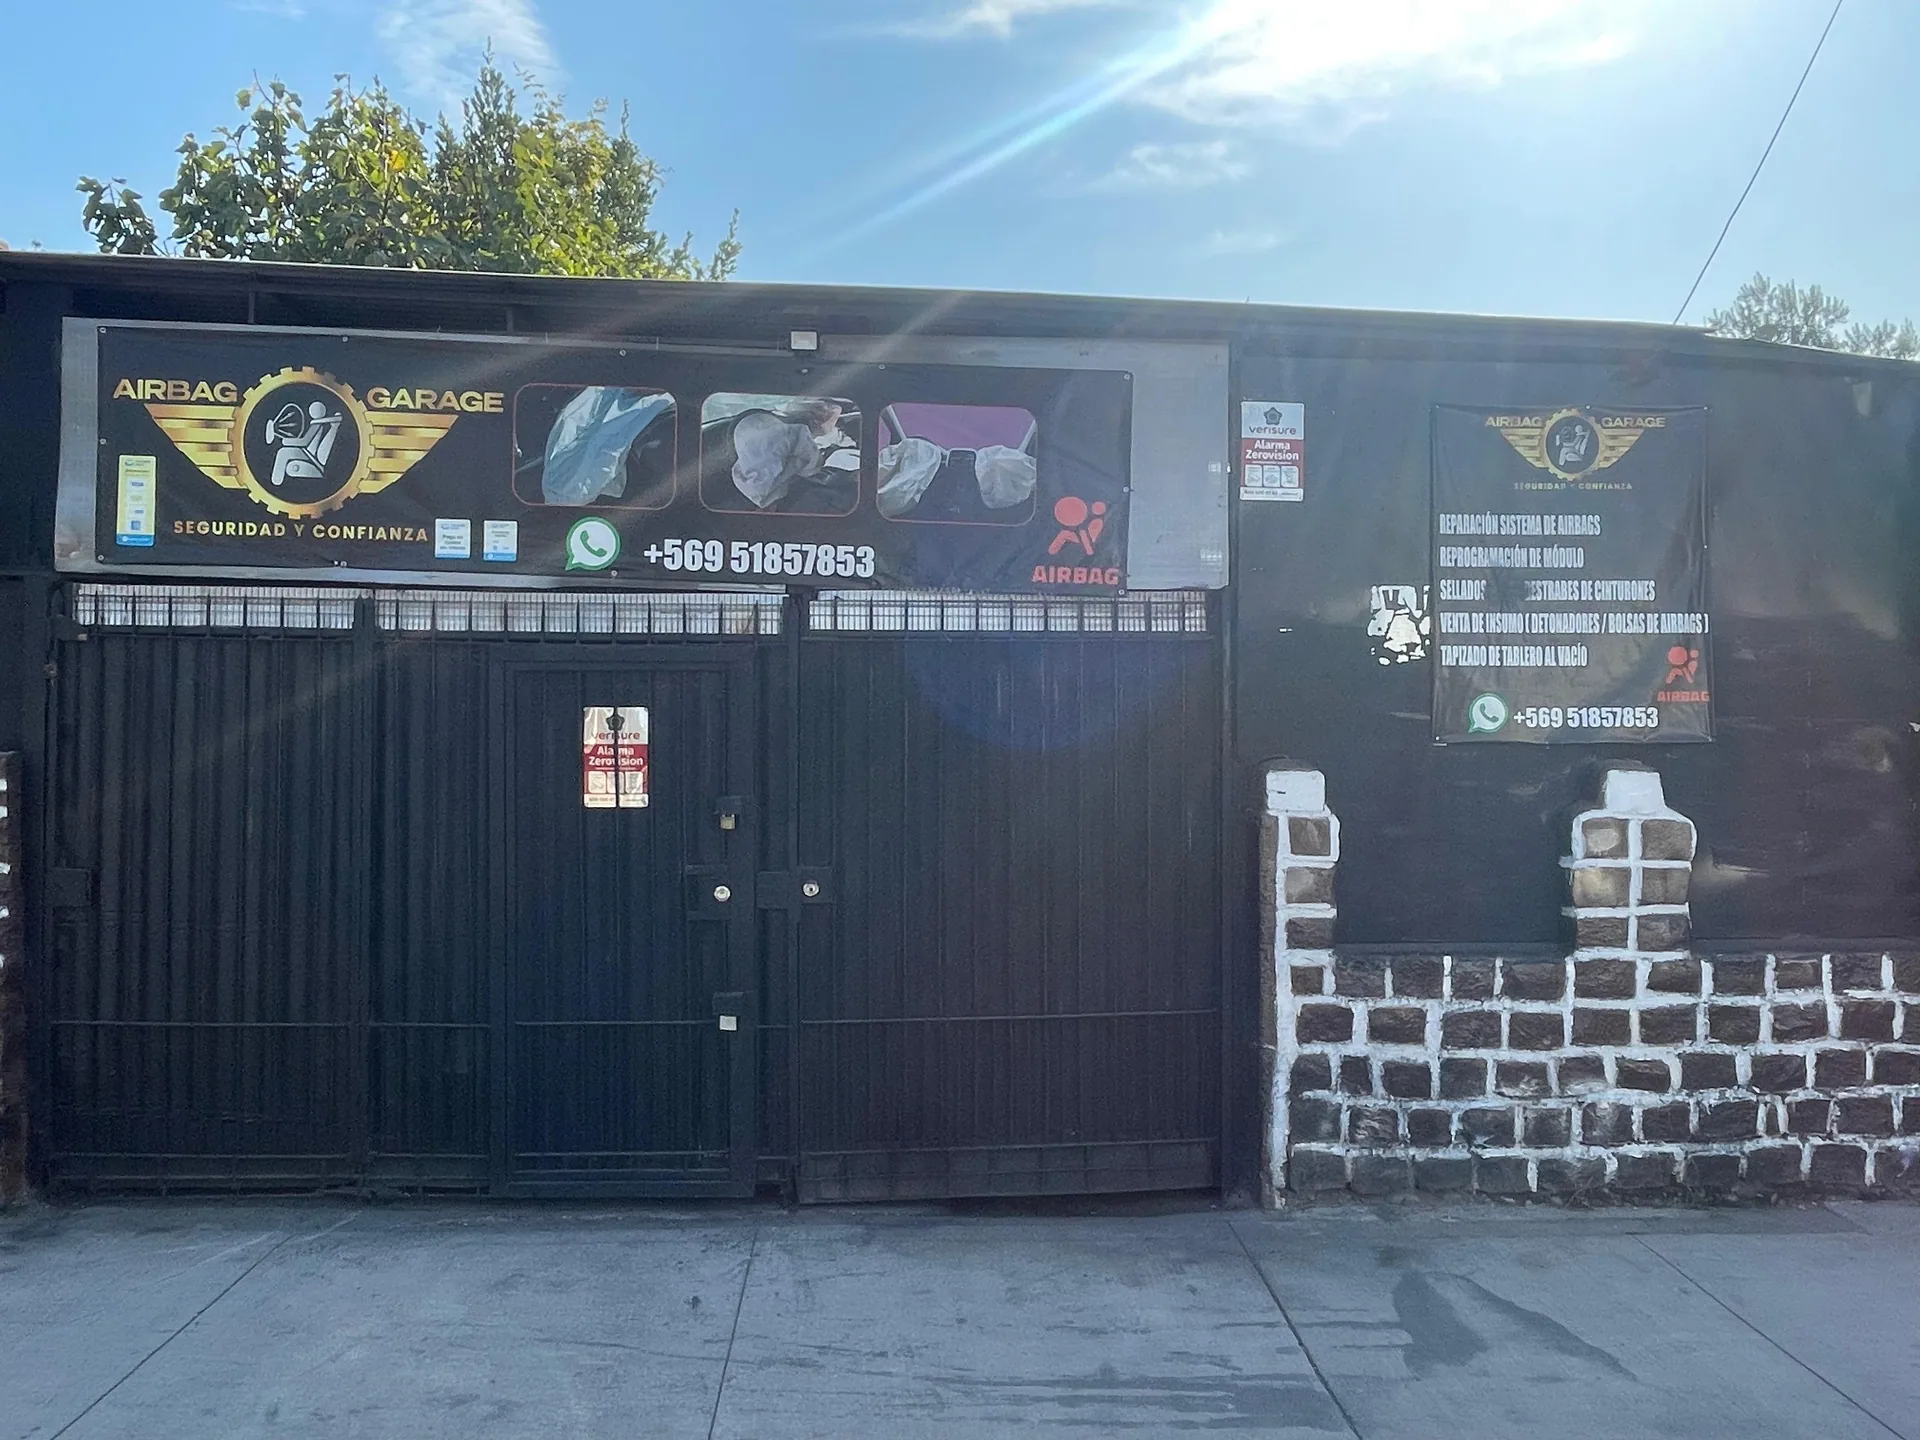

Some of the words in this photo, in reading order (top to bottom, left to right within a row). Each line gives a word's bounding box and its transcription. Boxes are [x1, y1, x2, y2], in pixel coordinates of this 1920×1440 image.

[113, 378, 238, 402] AIRBAG
[366, 386, 505, 413] GARAGE
[1248, 426, 1297, 435] verisure
[1485, 416, 1543, 427] AIRBAG
[1601, 417, 1666, 428] GARAGE
[1245, 449, 1299, 460] Zerovision
[1254, 440, 1290, 450] Alarma
[173, 520, 286, 538] SEGURIDAD
[294, 524, 305, 537] Y
[312, 524, 429, 543] CONFIANZA
[1439, 511, 1498, 535] REPARACIÓN
[1500, 514, 1542, 535] SISTEMA
[1544, 515, 1556, 535] DE
[1557, 515, 1601, 535] AIRBAGS
[643, 538, 724, 573] +569
[730, 541, 875, 578] 51857853
[1439, 544, 1527, 567] REPROGRAMACIÓN
[1529, 547, 1542, 567] DE
[1543, 544, 1585, 568] MÓDULO
[1032, 565, 1120, 585] AIRBAG
[1440, 579, 1487, 600] SELLADOS
[1580, 580, 1593, 600] DE
[1594, 580, 1656, 601] CINTURONES
[1440, 612, 1470, 633] VENTA
[1471, 613, 1484, 633] DE
[1485, 613, 1523, 634] INSUMO
[1531, 613, 1600, 634] DETONADORES
[1608, 613, 1645, 634] BOLSAS
[1646, 613, 1659, 633] DE
[1660, 613, 1703, 634] AIRBAGS
[1440, 645, 1487, 666] TAPIZADO
[1488, 645, 1500, 666] DE
[1501, 645, 1543, 666] TABLERO
[1544, 645, 1557, 666] AL
[1557, 642, 1588, 667] VACÍO
[1657, 691, 1711, 702] AIRBAG
[1513, 707, 1563, 728] +569
[1567, 707, 1659, 728] 51857853
[597, 746, 634, 755] Alama
